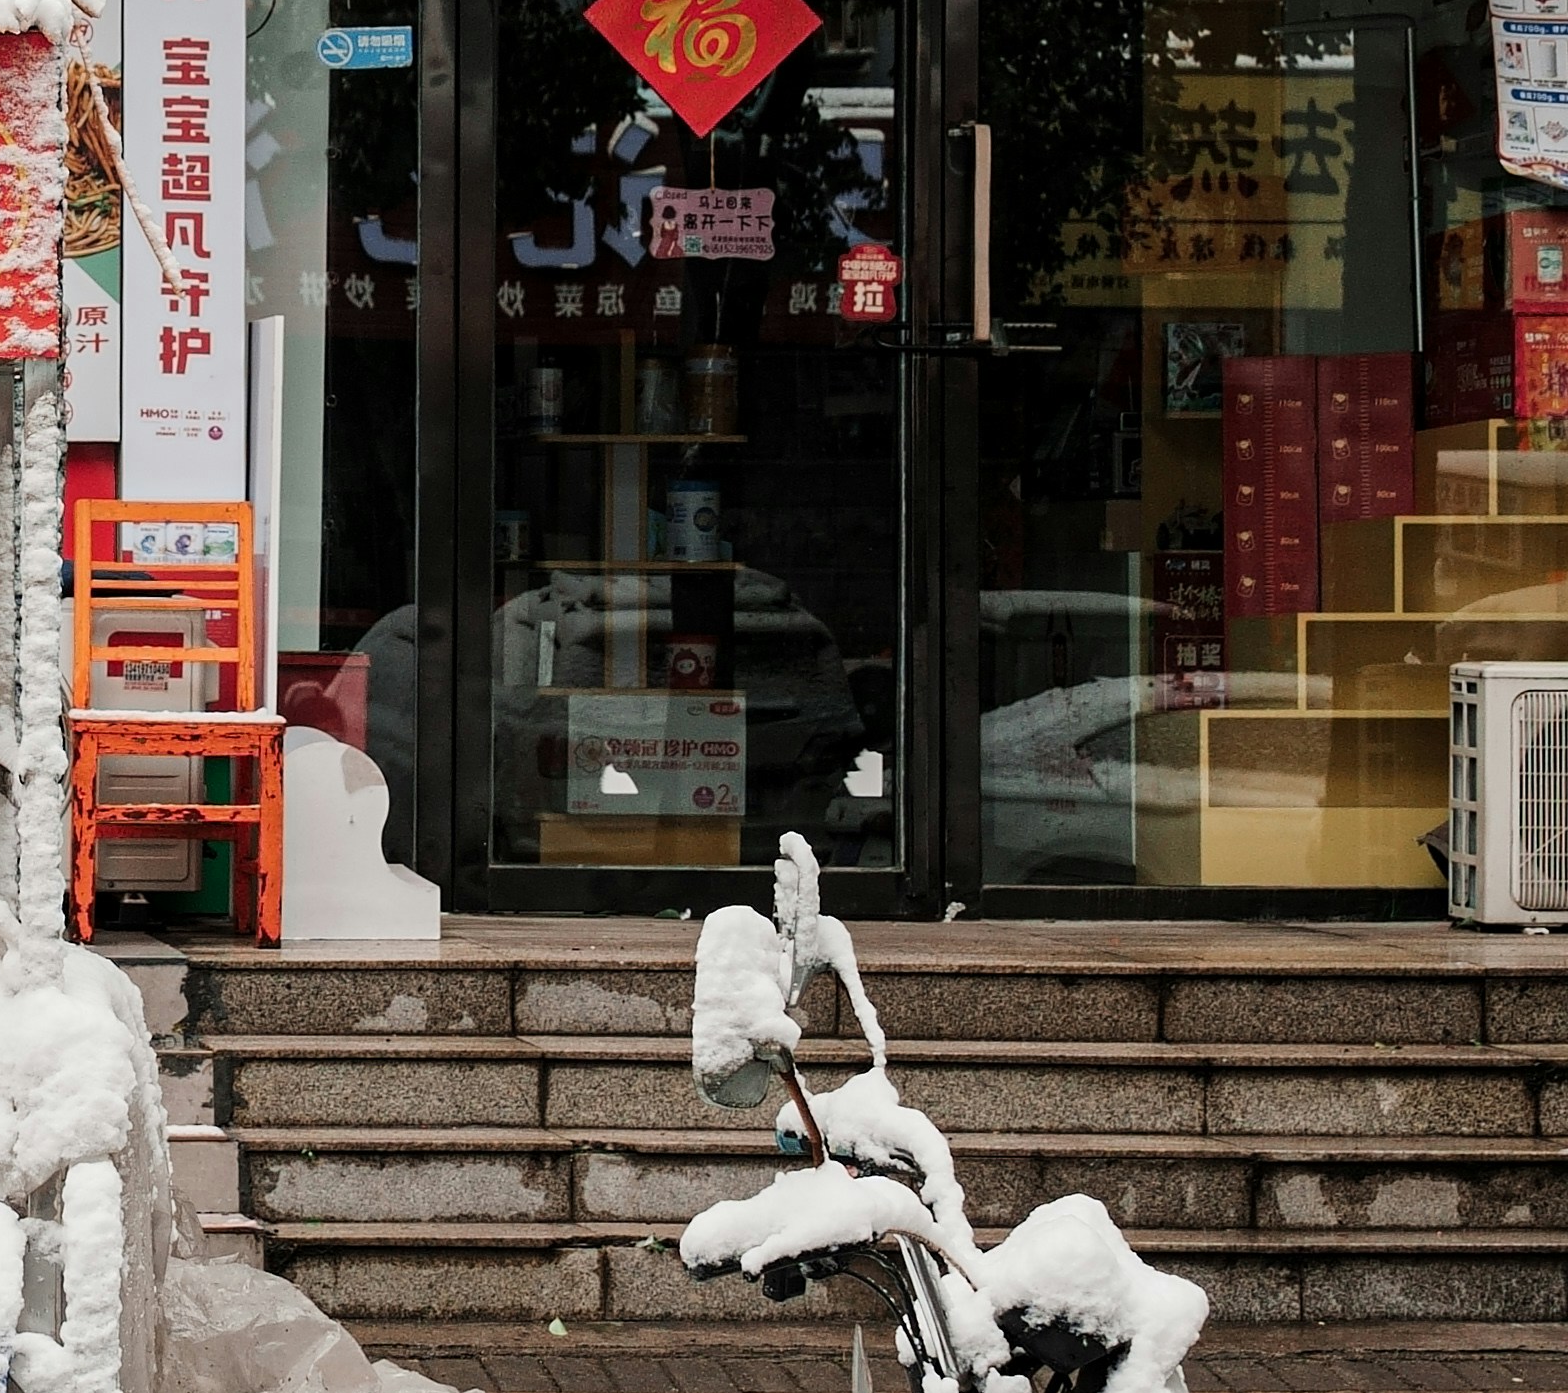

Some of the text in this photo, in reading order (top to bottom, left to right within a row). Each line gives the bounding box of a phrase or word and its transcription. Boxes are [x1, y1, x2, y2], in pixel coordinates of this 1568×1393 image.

[159, 37, 212, 376] 宝宝超凡守护
[699, 195, 752, 210] 马上回来
[683, 213, 771, 231] 离开一下下
[853, 281, 885, 313] 拉
[75, 306, 110, 354] 原汁
[140, 408, 170, 419] HMO
[704, 743, 737, 755] HMO
